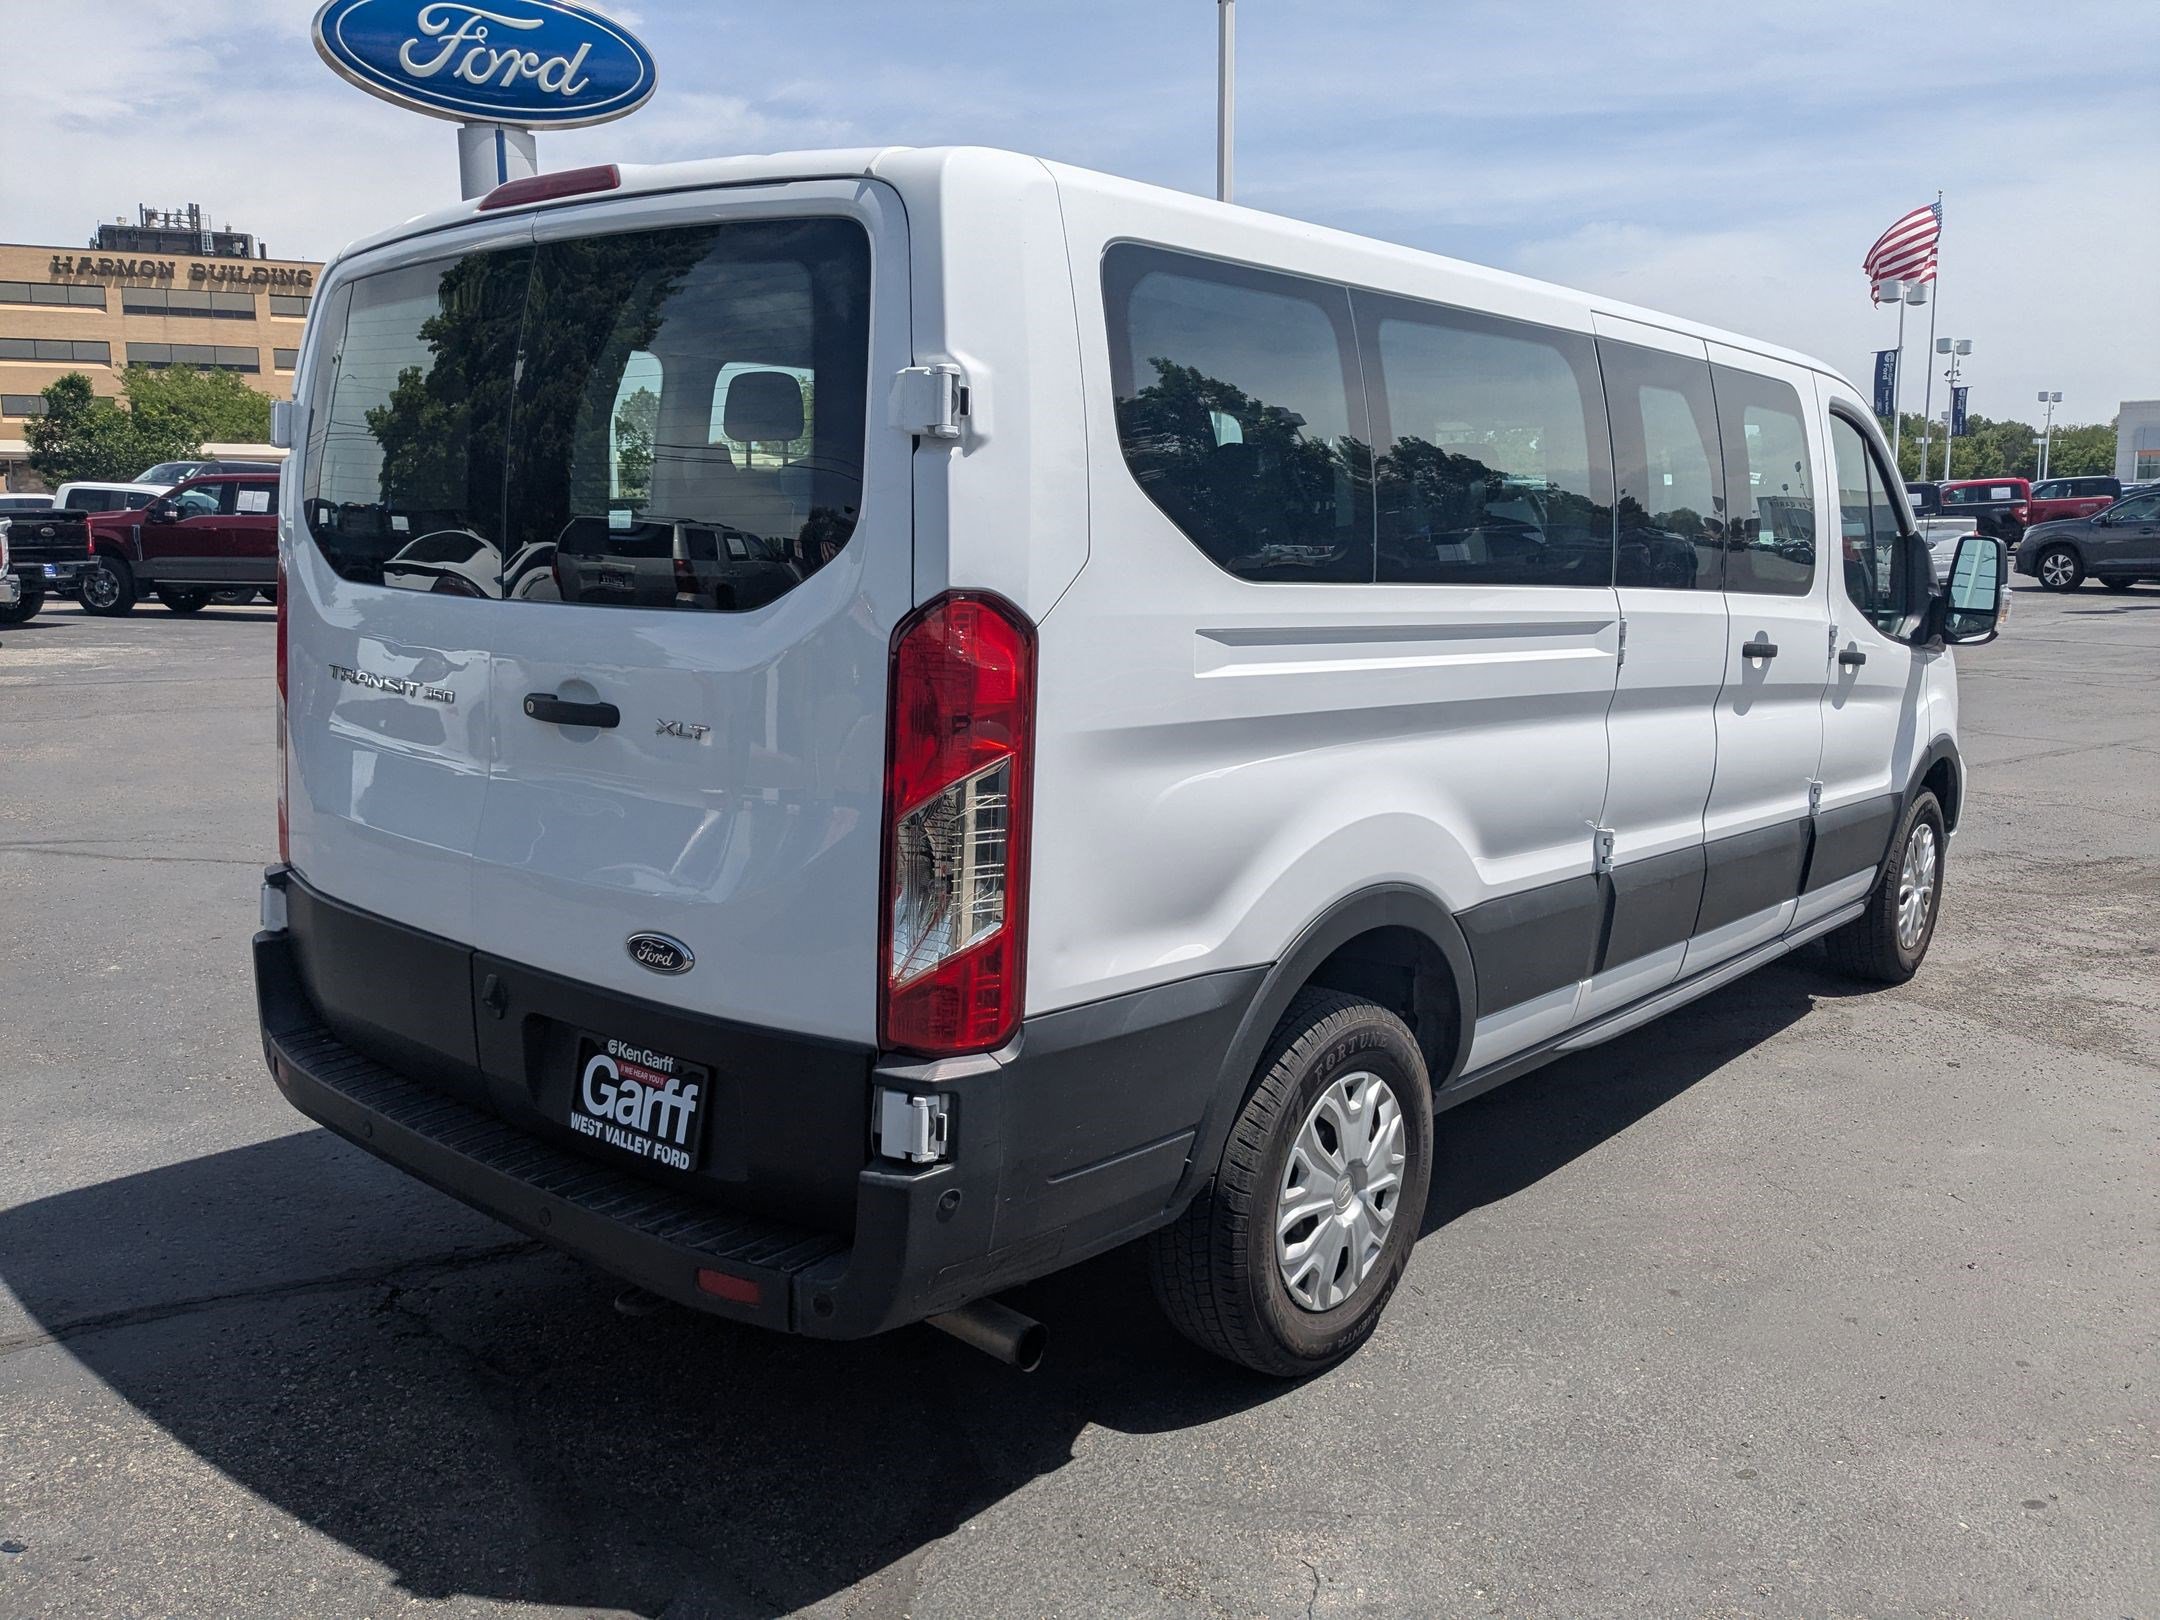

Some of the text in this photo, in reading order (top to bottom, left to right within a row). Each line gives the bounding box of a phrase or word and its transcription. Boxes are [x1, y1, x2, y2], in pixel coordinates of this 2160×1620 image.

[400, 3, 593, 97] Ford
[53, 255, 314, 288] HARMON BUILDING
[329, 664, 456, 704] TRANSIT 350
[656, 718, 711, 740] XLT
[637, 940, 674, 966] Ford
[617, 1040, 674, 1073] Ken Garff
[1315, 1031, 1389, 1085] FORTUNE
[624, 1066, 661, 1084] WE HEAR YOU
[582, 1054, 699, 1145] Garff
[570, 1112, 690, 1170] WEST VALLEY FORD
